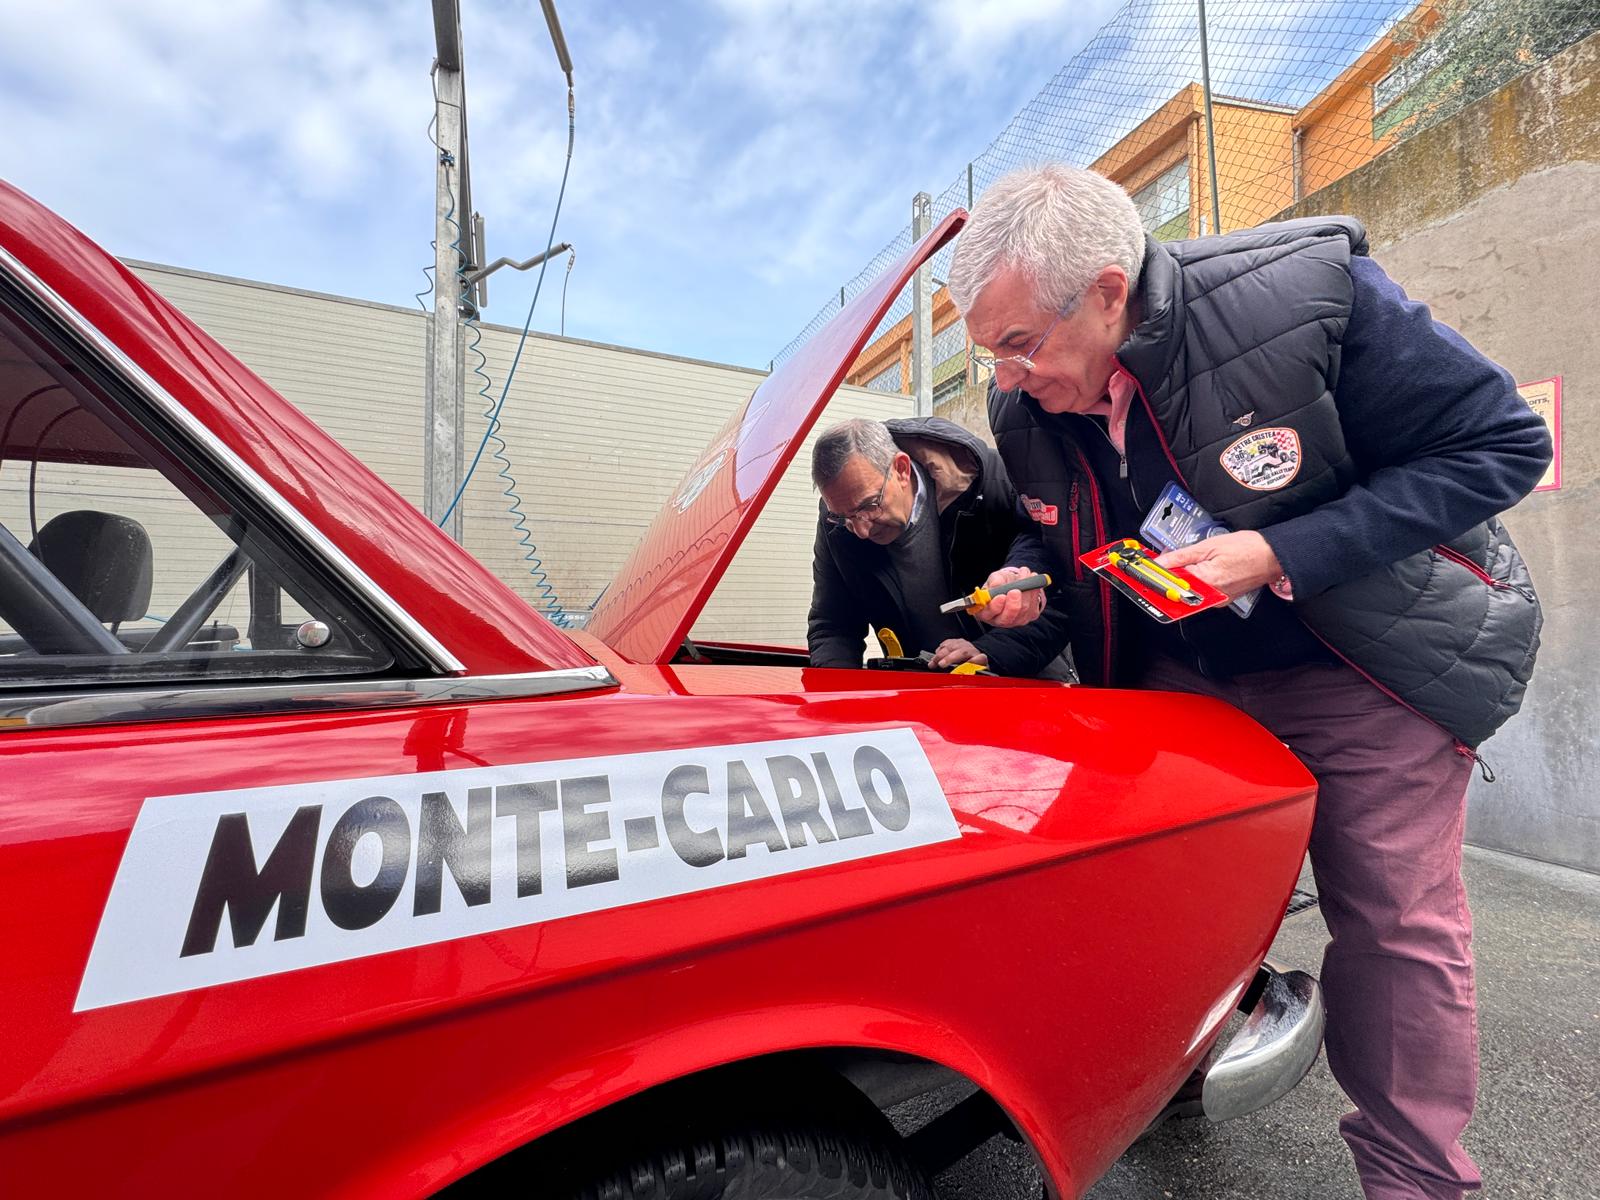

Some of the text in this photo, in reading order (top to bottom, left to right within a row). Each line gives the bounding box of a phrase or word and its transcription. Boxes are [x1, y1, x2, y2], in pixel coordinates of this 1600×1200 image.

[1233, 431, 1276, 451] PETRE CRISTEA
[179, 745, 911, 958] MONTE-CARLO
